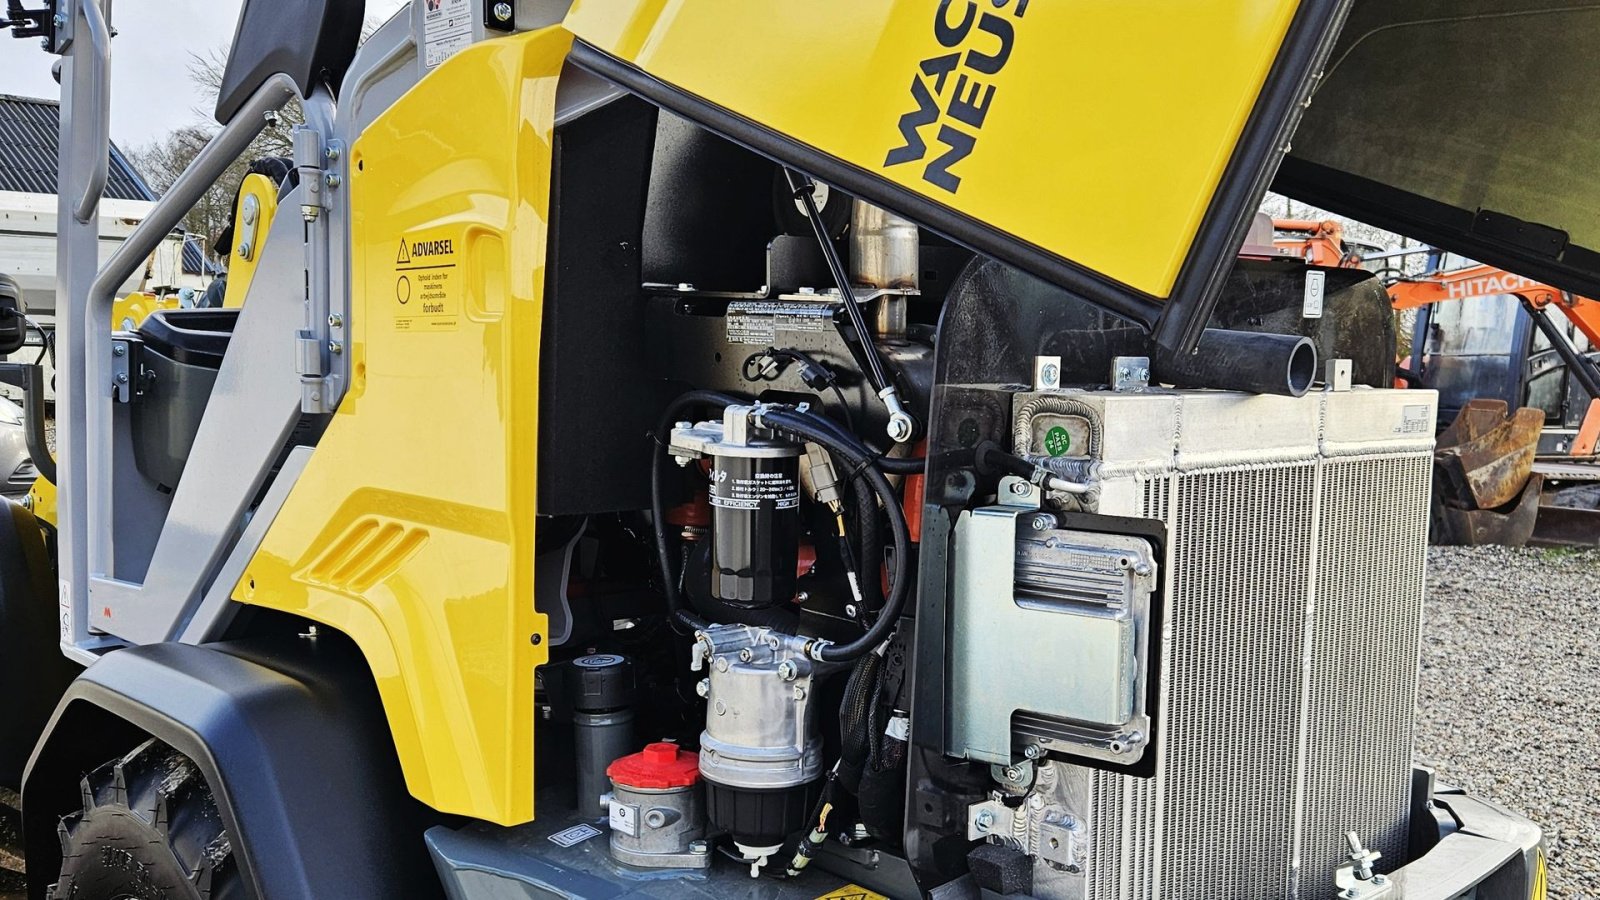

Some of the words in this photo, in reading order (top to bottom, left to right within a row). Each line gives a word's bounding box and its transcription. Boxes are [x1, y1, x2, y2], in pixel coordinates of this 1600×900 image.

[412, 239, 453, 257] ADVARSEL
[423, 303, 444, 313] forbudt
[1054, 432, 1062, 451] PASS
[1061, 434, 1067, 445] QC
